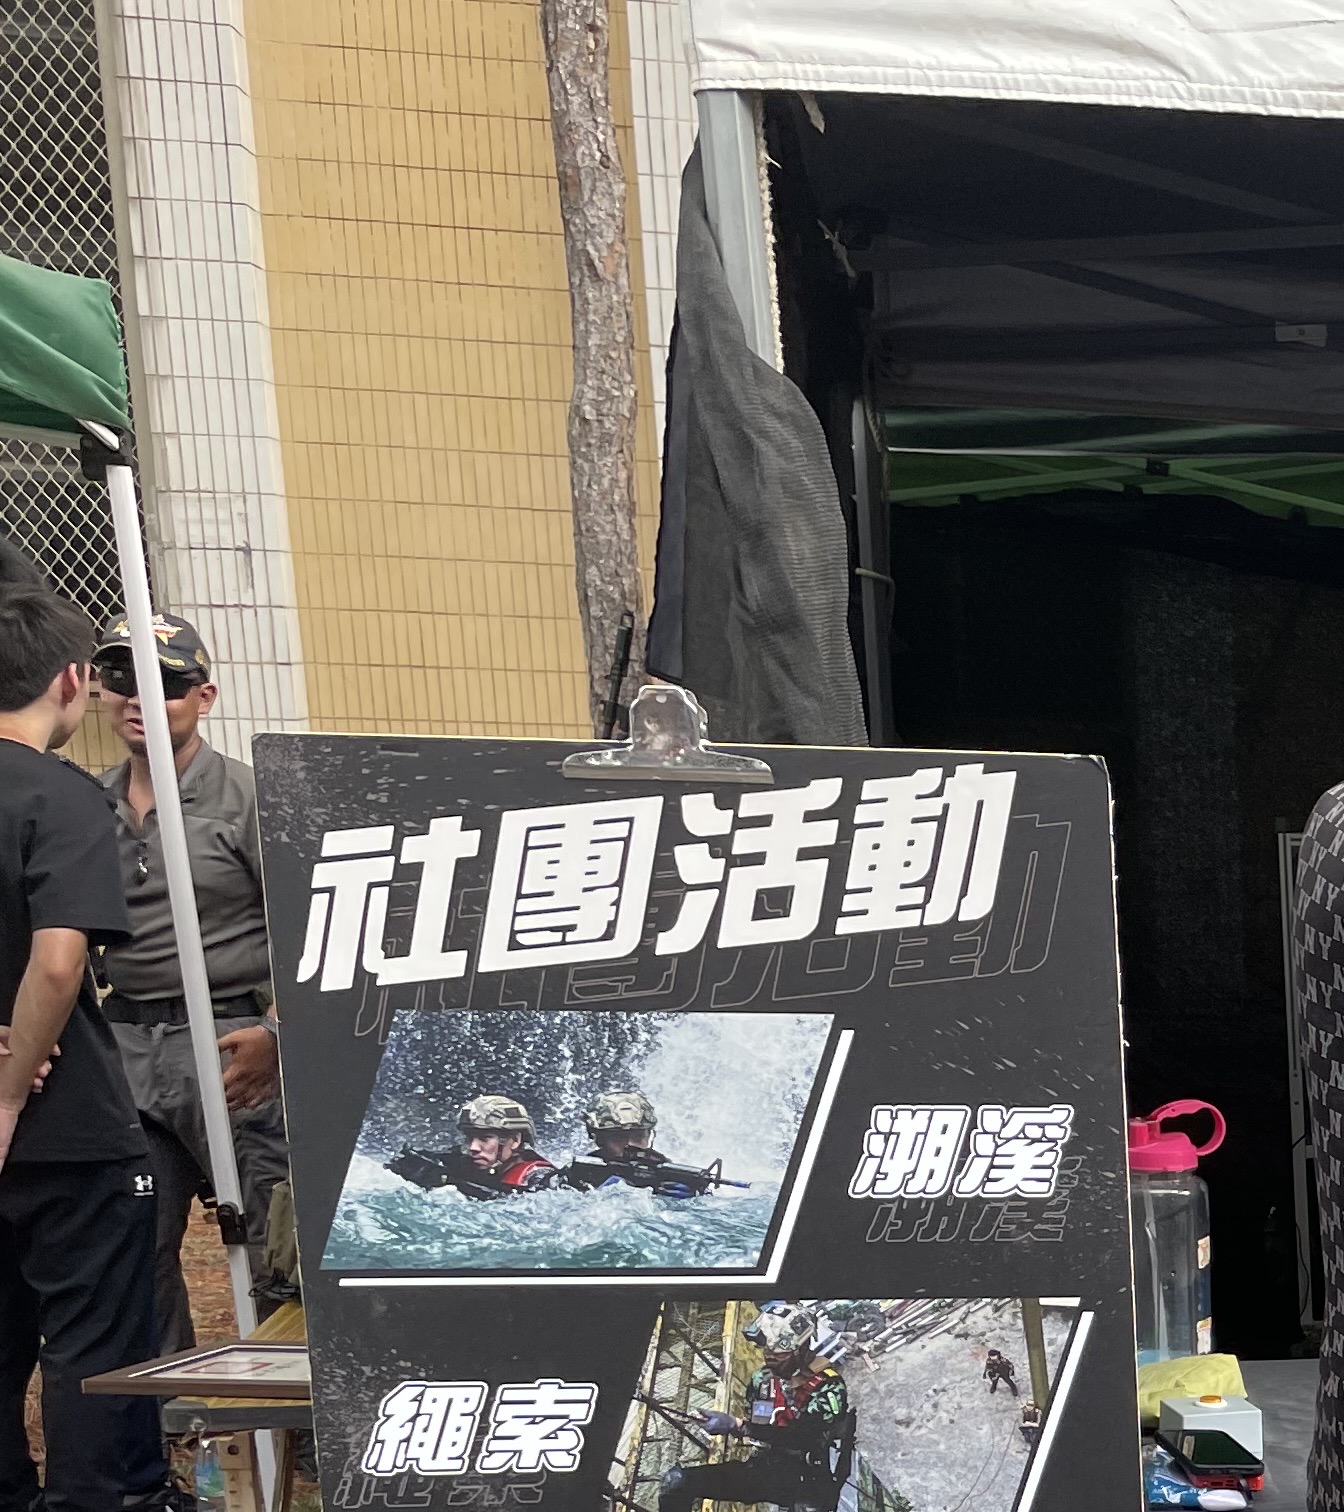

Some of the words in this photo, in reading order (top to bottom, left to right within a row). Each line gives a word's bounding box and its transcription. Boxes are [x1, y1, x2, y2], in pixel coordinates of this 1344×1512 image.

[295, 765, 1017, 992] 社團活動
[1312, 878, 1338, 911] NY
[1304, 928, 1331, 960] NY
[1306, 978, 1333, 1009] NY
[848, 1105, 1076, 1199] 溯溪
[361, 1378, 599, 1476] 繩索
